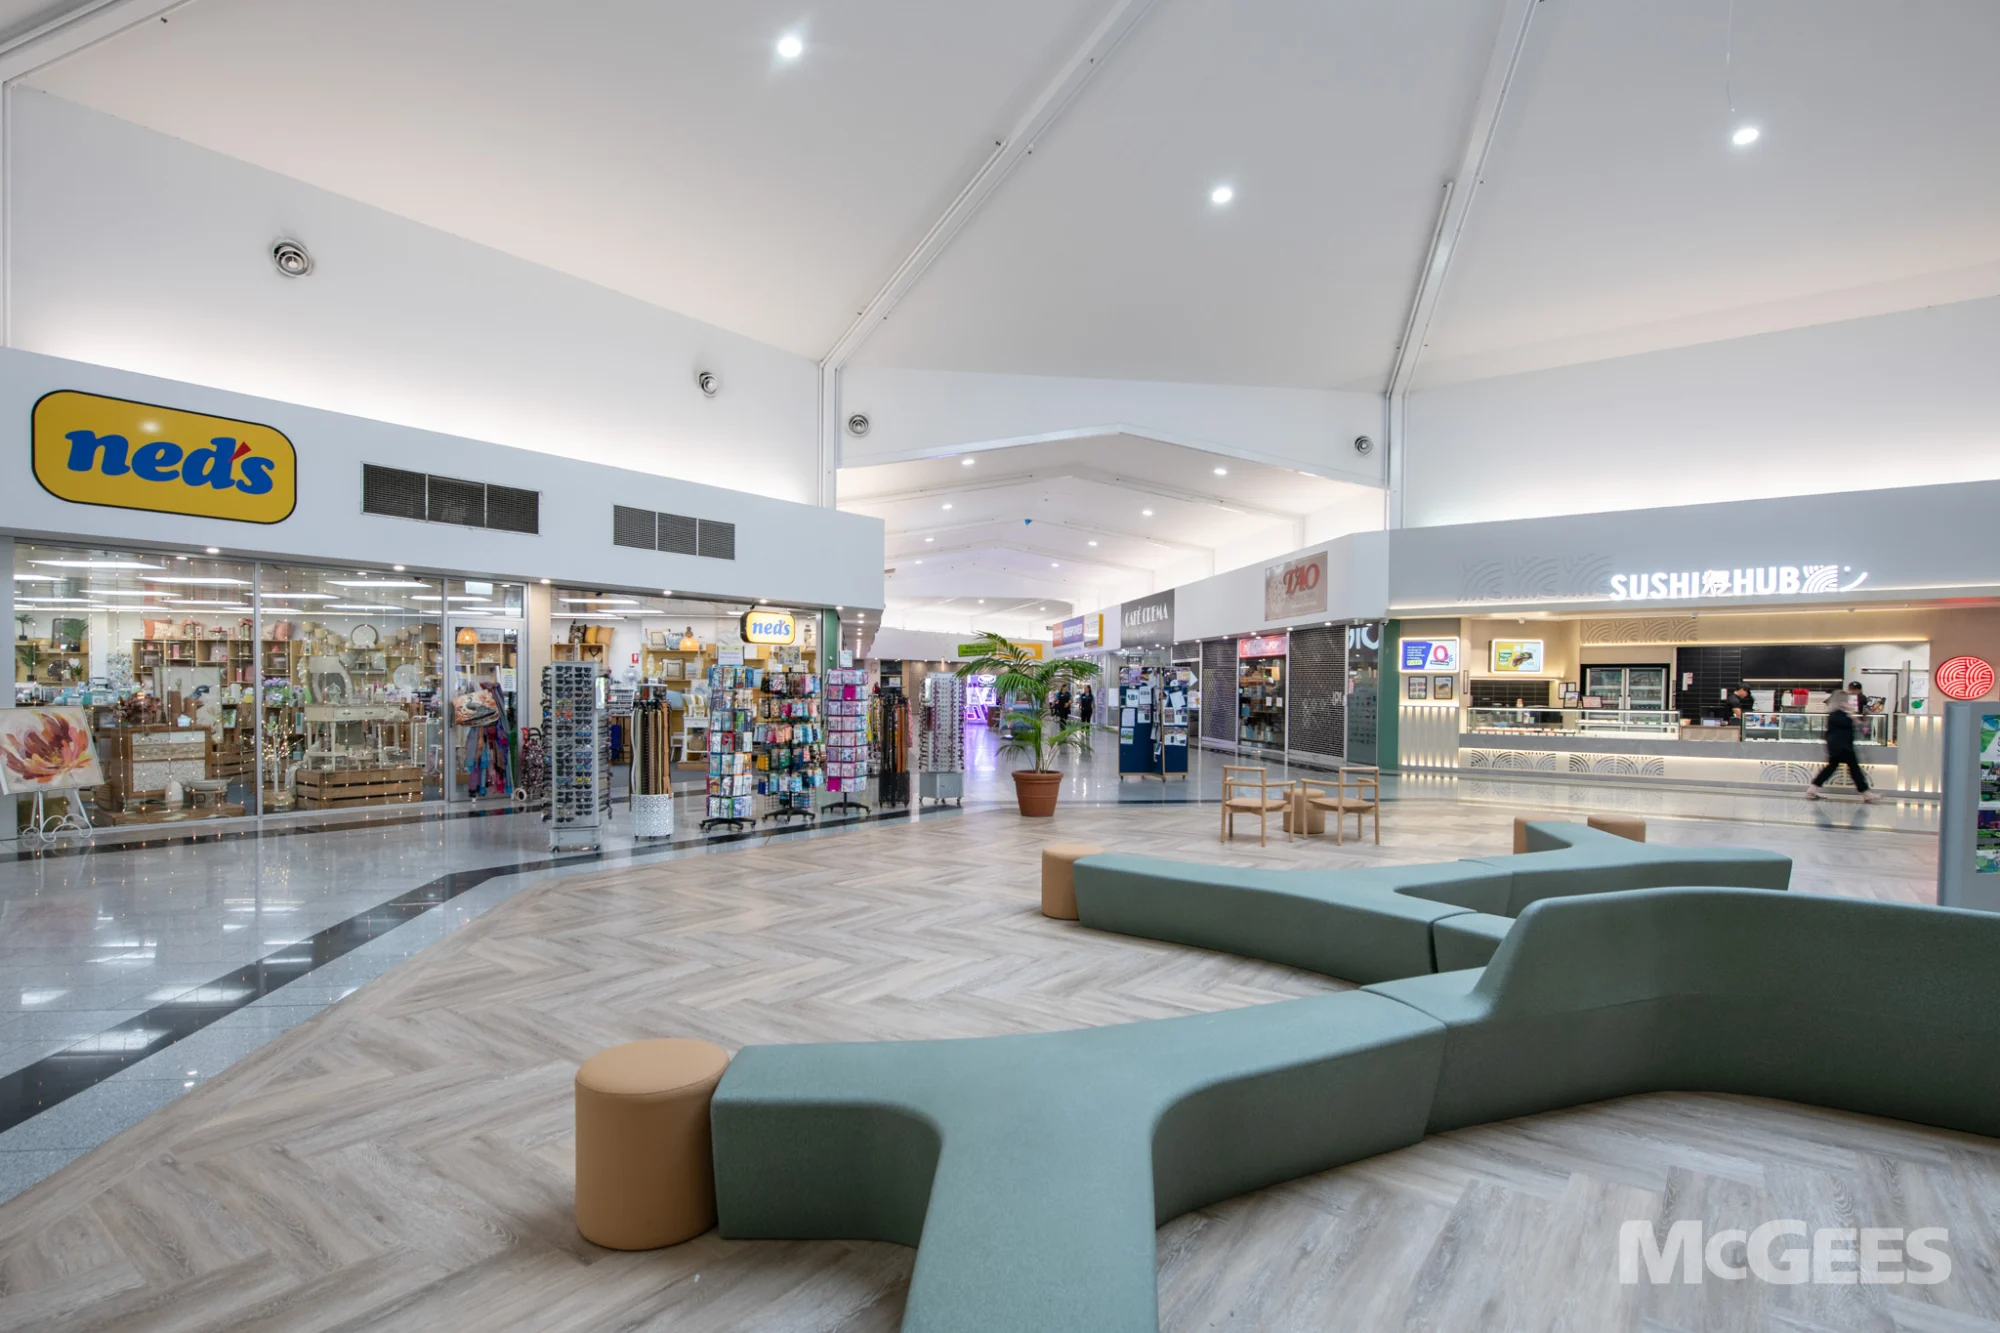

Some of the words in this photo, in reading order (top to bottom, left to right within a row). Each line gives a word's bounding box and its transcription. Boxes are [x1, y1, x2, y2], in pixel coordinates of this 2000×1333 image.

[64, 430, 275, 495] ned's
[1283, 563, 1320, 596] TAO
[1609, 571, 1700, 601] SUSHI
[1733, 566, 1800, 596] HUB
[752, 619, 791, 636] ned's
